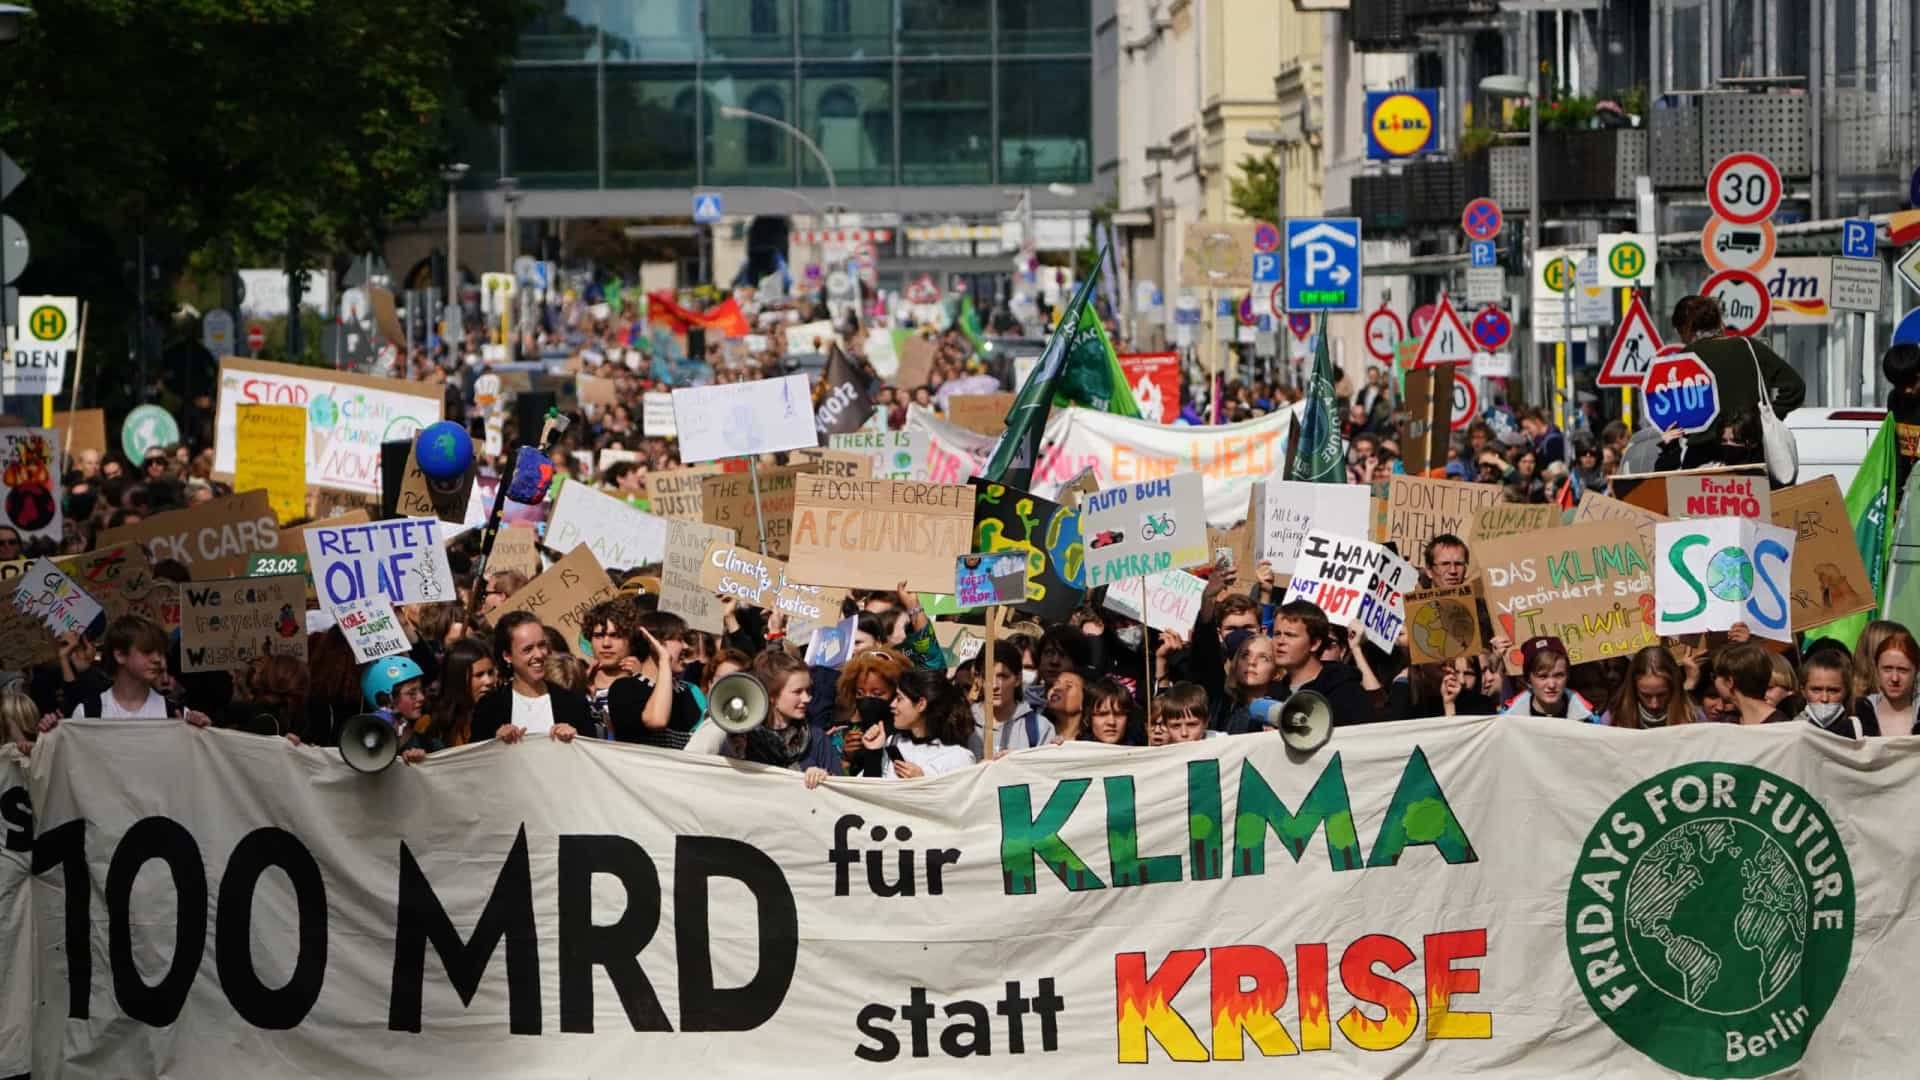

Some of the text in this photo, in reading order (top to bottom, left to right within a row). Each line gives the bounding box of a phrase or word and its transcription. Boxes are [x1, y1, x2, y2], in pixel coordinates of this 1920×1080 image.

[1723, 173, 1766, 206] 30
[1767, 267, 1819, 298] dm
[242, 379, 309, 406] STOP
[1653, 374, 1713, 417] STOP
[836, 430, 911, 449] THERE IS
[709, 480, 741, 498] THE
[891, 480, 964, 507] FORGET
[1087, 478, 1171, 514] AUTO BUH
[1394, 479, 1449, 509] DONT
[1700, 477, 1754, 496] Findet
[715, 504, 731, 521] IS
[1479, 507, 1547, 531] CLIMATE
[1686, 495, 1761, 518] NEMO
[197, 515, 276, 562] CARS
[317, 518, 437, 557] RETTET
[795, 509, 971, 555] AFGHANISTAN
[1391, 510, 1436, 538] WITH
[1439, 515, 1464, 538] MY
[256, 558, 297, 574] 23.09.
[711, 548, 770, 580] Climate
[1090, 550, 1172, 588] FAHRRAD
[1303, 536, 1330, 558] I
[1333, 544, 1391, 574] WANT
[1389, 565, 1401, 584] A
[1488, 540, 1649, 590] DAS KLIMA
[559, 568, 580, 589] IS
[717, 574, 762, 605] Social
[1318, 561, 1402, 608] HOT DATE
[1496, 575, 1607, 614] verändert
[188, 590, 221, 606] We
[1290, 575, 1402, 643] NOT HOT PLANET
[828, 744, 1480, 897] für KLIMA
[1575, 771, 1844, 1013] FRIDAYS FOR FUTURE
[31, 815, 799, 1036] 100 MRD
[853, 927, 1493, 1065] statt KRISE
[1725, 1003, 1810, 1063] Berlin
